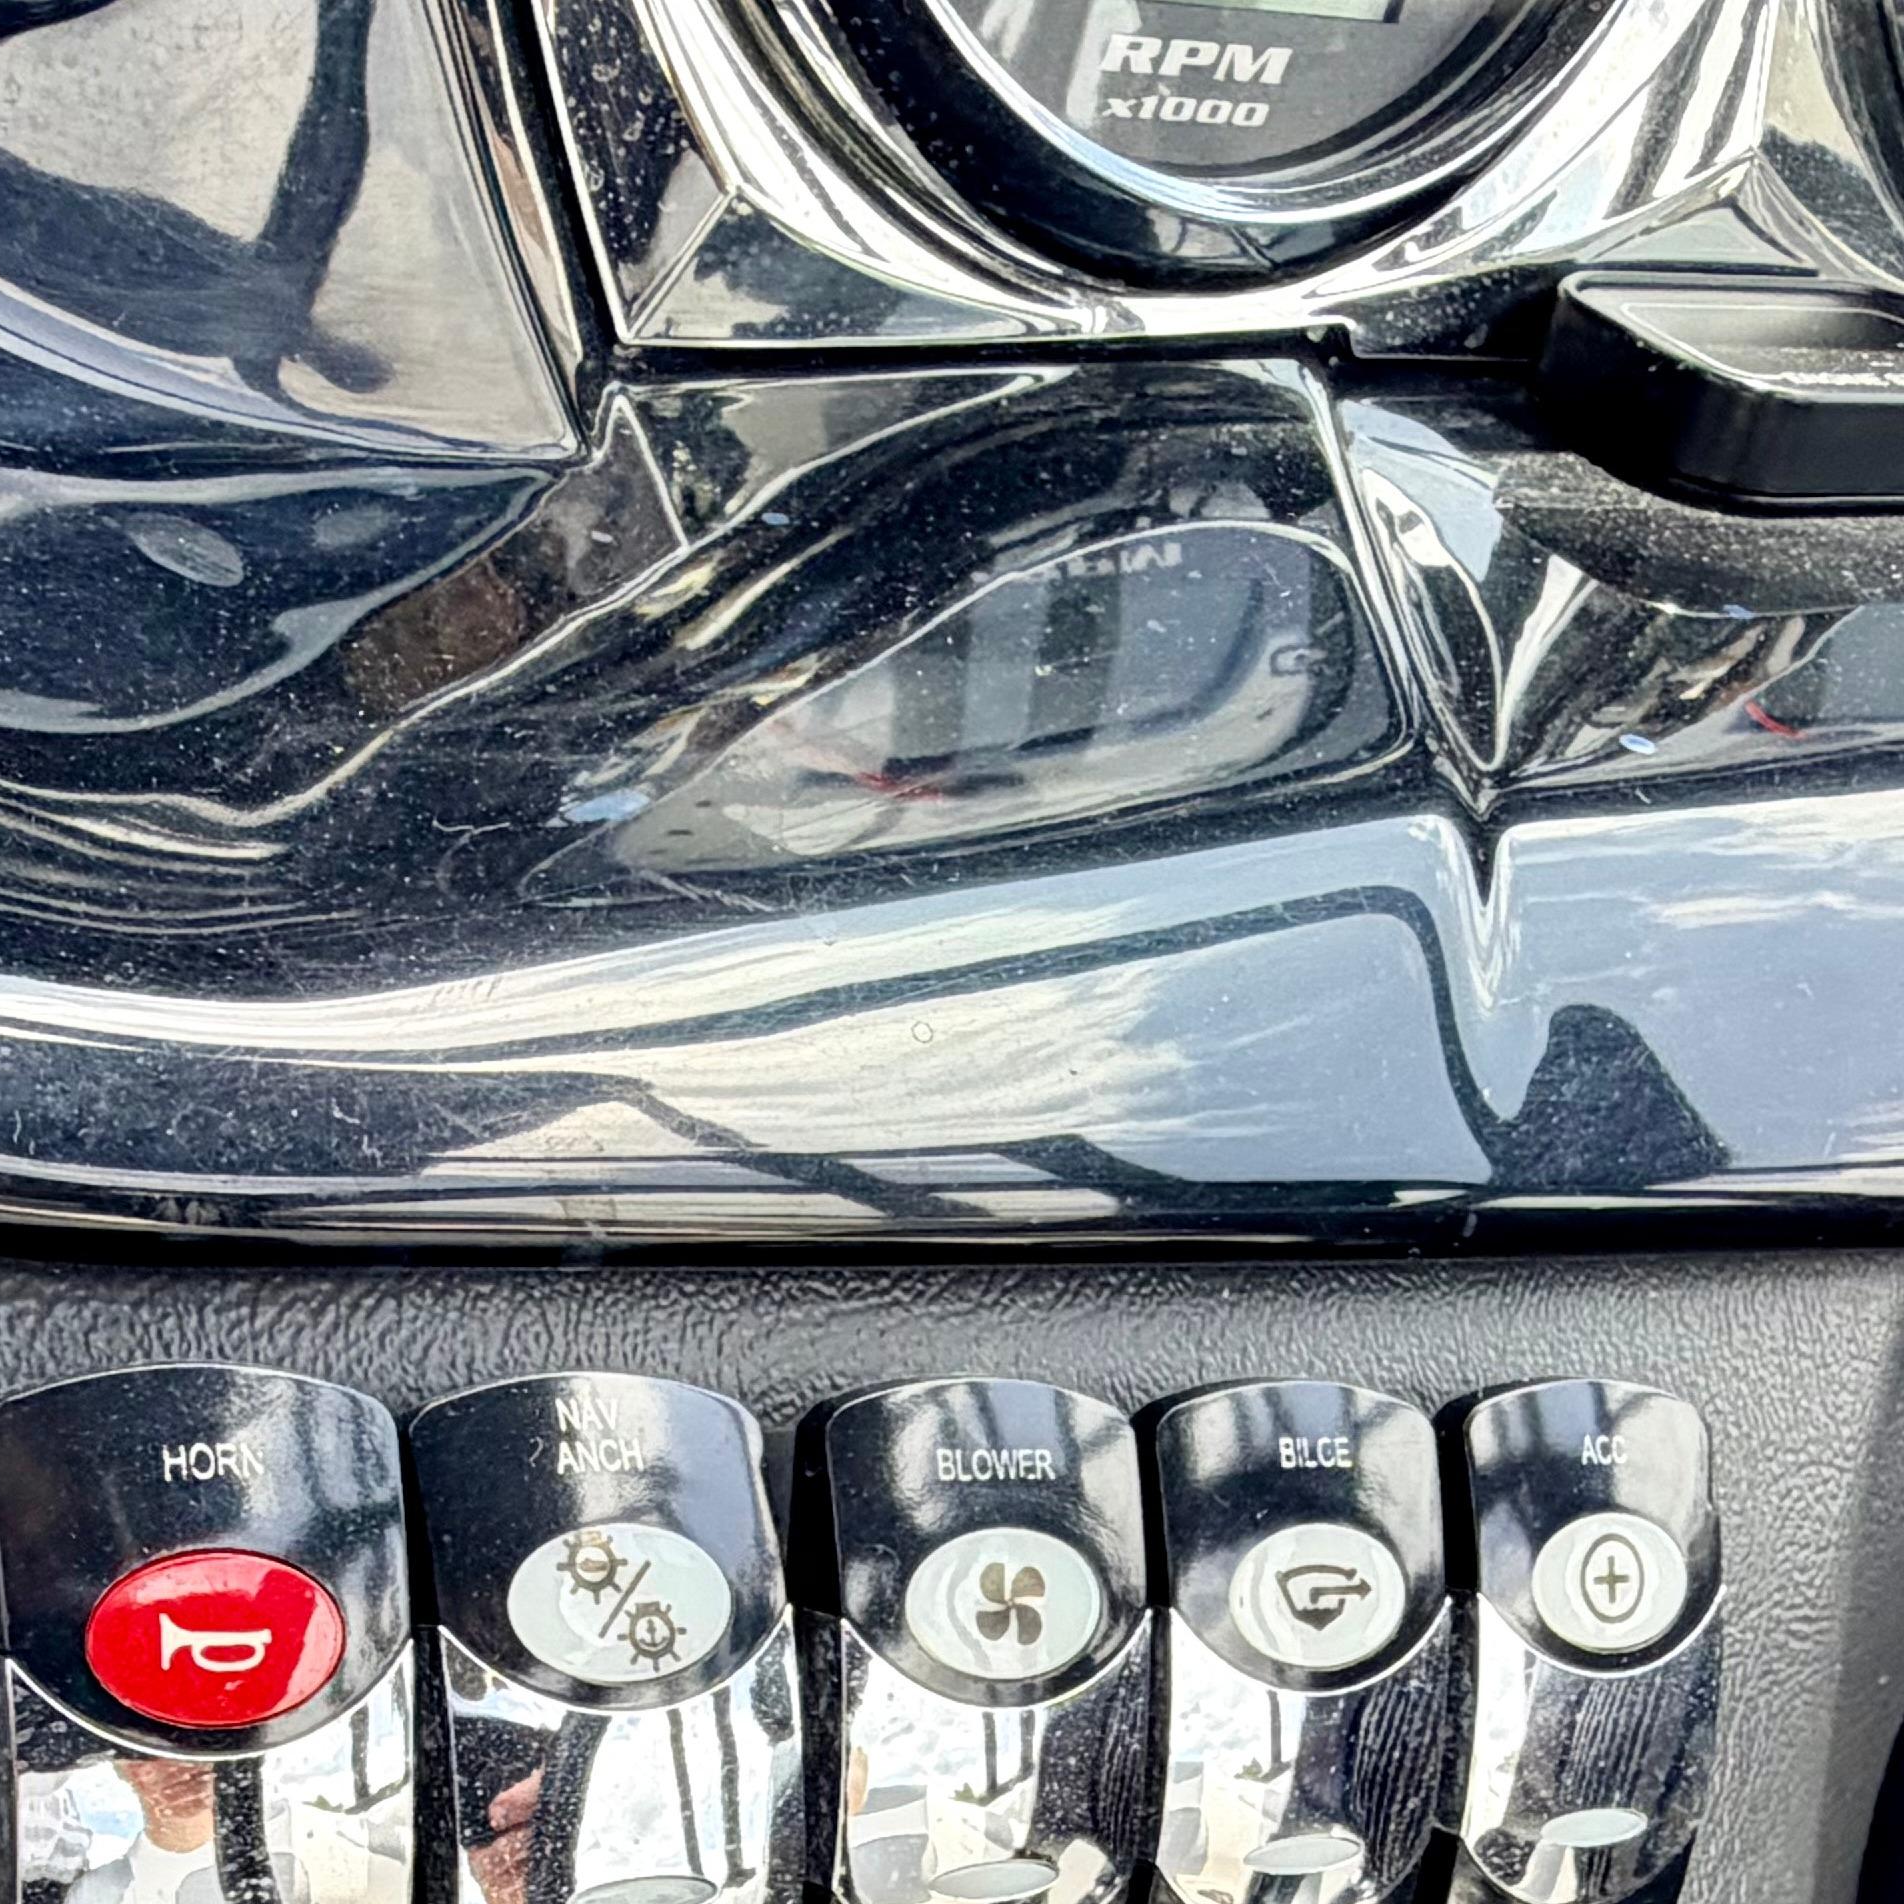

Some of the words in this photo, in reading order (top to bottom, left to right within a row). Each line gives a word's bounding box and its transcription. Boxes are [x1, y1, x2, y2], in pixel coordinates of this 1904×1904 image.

[1100, 34, 1293, 84] RPM
[1102, 95, 1269, 127] x1000
[554, 1397, 621, 1431] NAV
[162, 1442, 265, 1482] HORN
[556, 1438, 643, 1475] ANCH
[936, 1447, 1057, 1482] BLOWER
[1581, 1435, 1627, 1467] ACC
